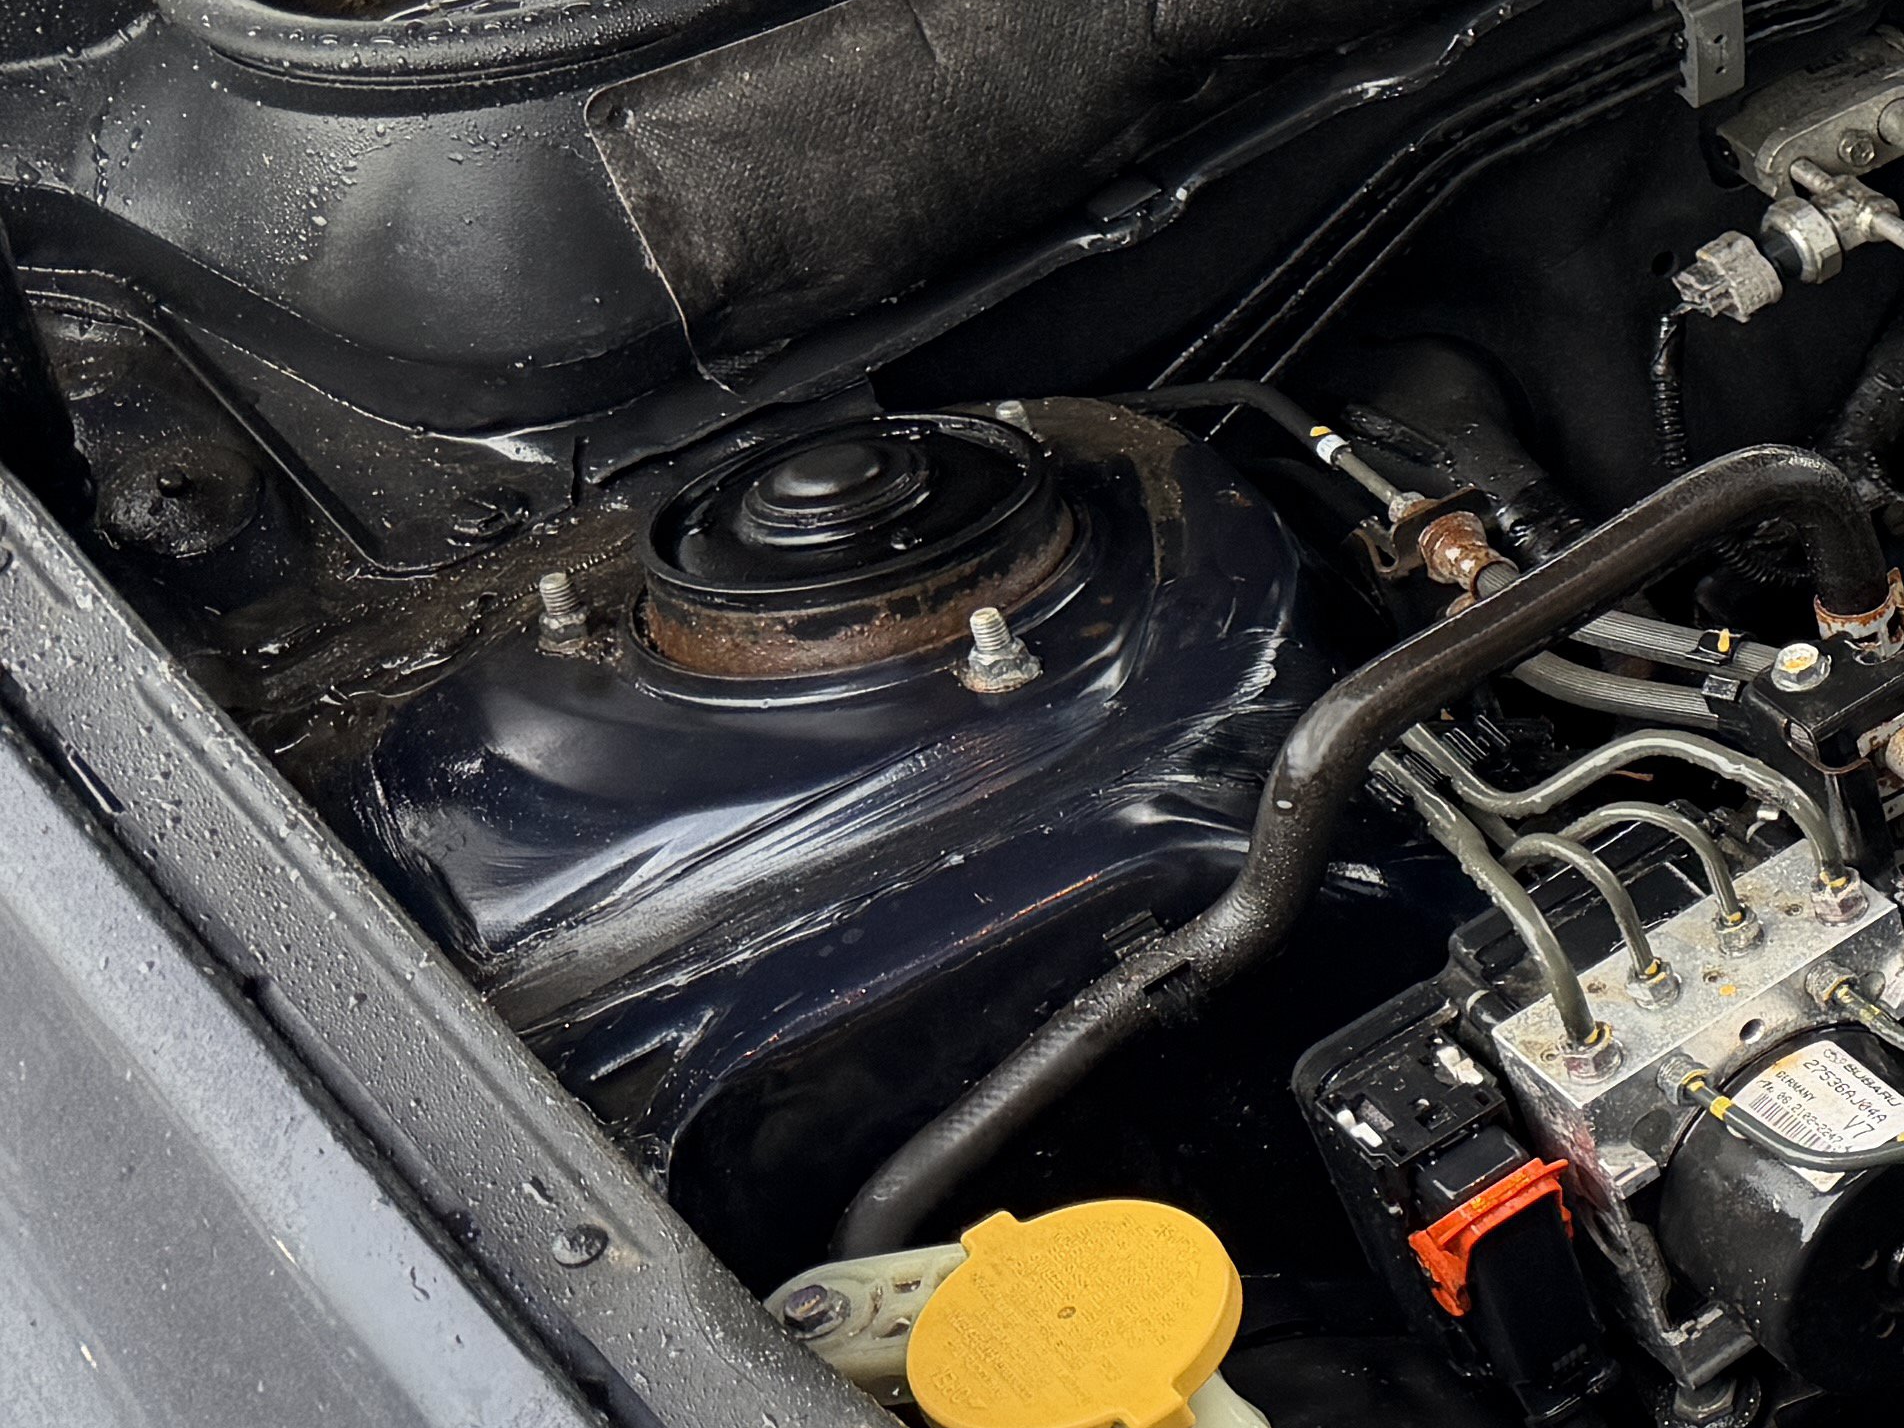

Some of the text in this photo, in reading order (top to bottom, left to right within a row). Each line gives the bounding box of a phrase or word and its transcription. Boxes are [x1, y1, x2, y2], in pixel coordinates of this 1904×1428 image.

[1774, 1069, 1816, 1103] GERMANY
[1842, 1062, 1902, 1110] SUBARU
[1842, 1114, 1876, 1141] V7
